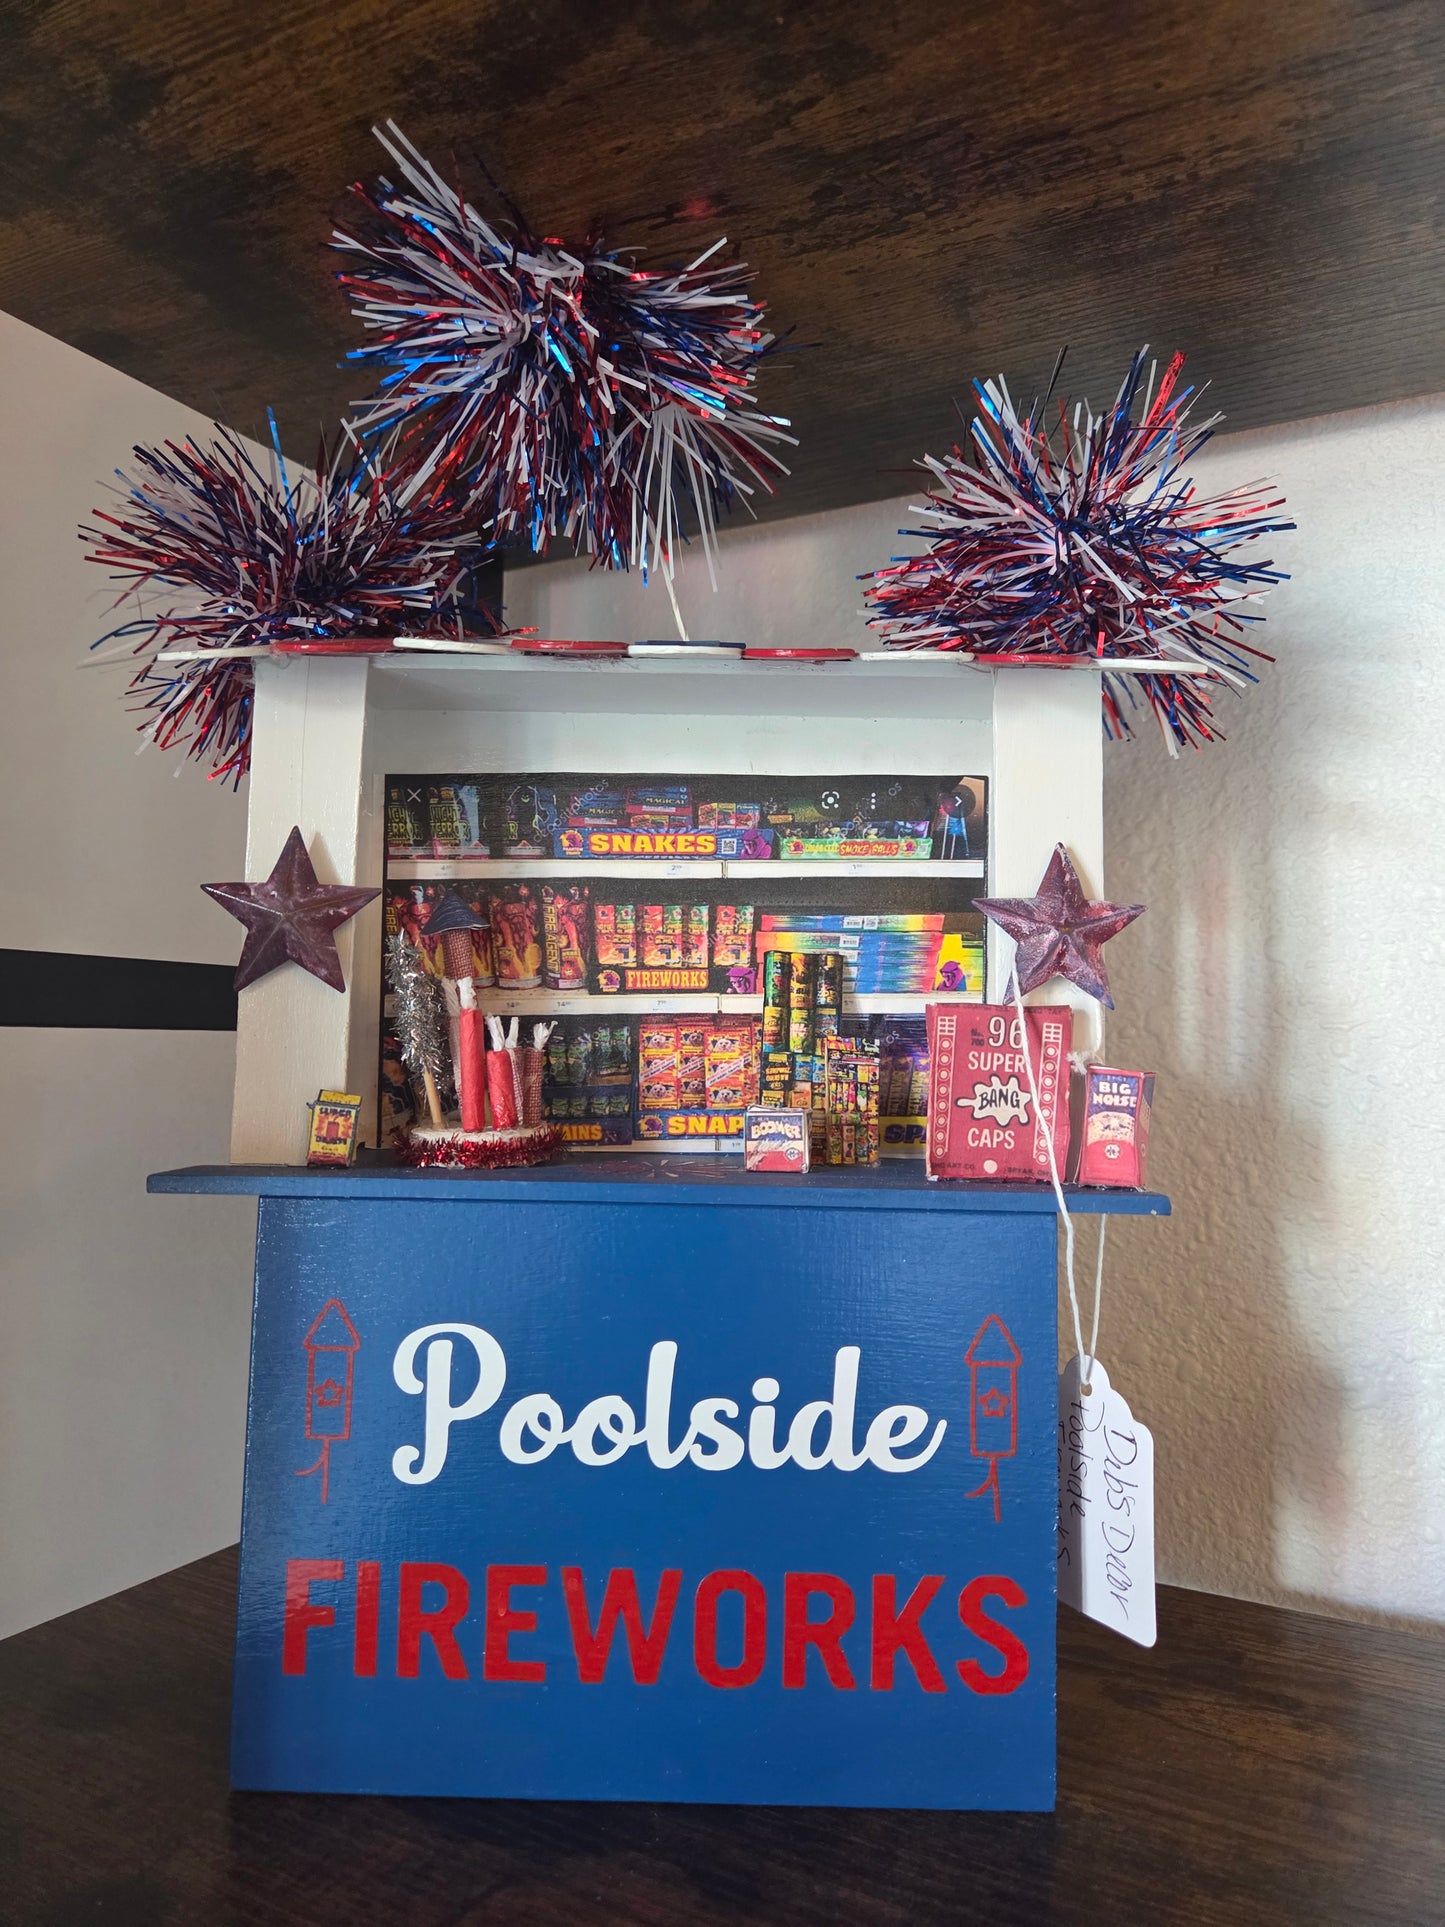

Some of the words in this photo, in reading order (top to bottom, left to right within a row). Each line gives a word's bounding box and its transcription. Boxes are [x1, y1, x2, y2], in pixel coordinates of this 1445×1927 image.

[590, 834, 717, 854] SNAKES
[840, 843, 870, 856] SMOKE
[872, 843, 898, 856] BALLS
[385, 906, 397, 933] FIRE
[544, 905, 558, 931] FIRE
[547, 933, 560, 972] AGENT
[627, 969, 708, 988] FIREWORKS
[987, 1016, 1024, 1049] 96
[968, 1051, 1025, 1073] SUPER
[979, 1088, 1020, 1111] BANG
[1098, 1081, 1131, 1095] BIG
[1093, 1092, 1137, 1108] NOISE
[751, 1120, 801, 1139] BOOMER
[967, 1127, 1015, 1150] CAPS
[391, 1322, 948, 1486] Poolside
[1066, 1399, 1105, 1518] Poolside
[280, 1557, 1031, 1697] FIREWORKS
